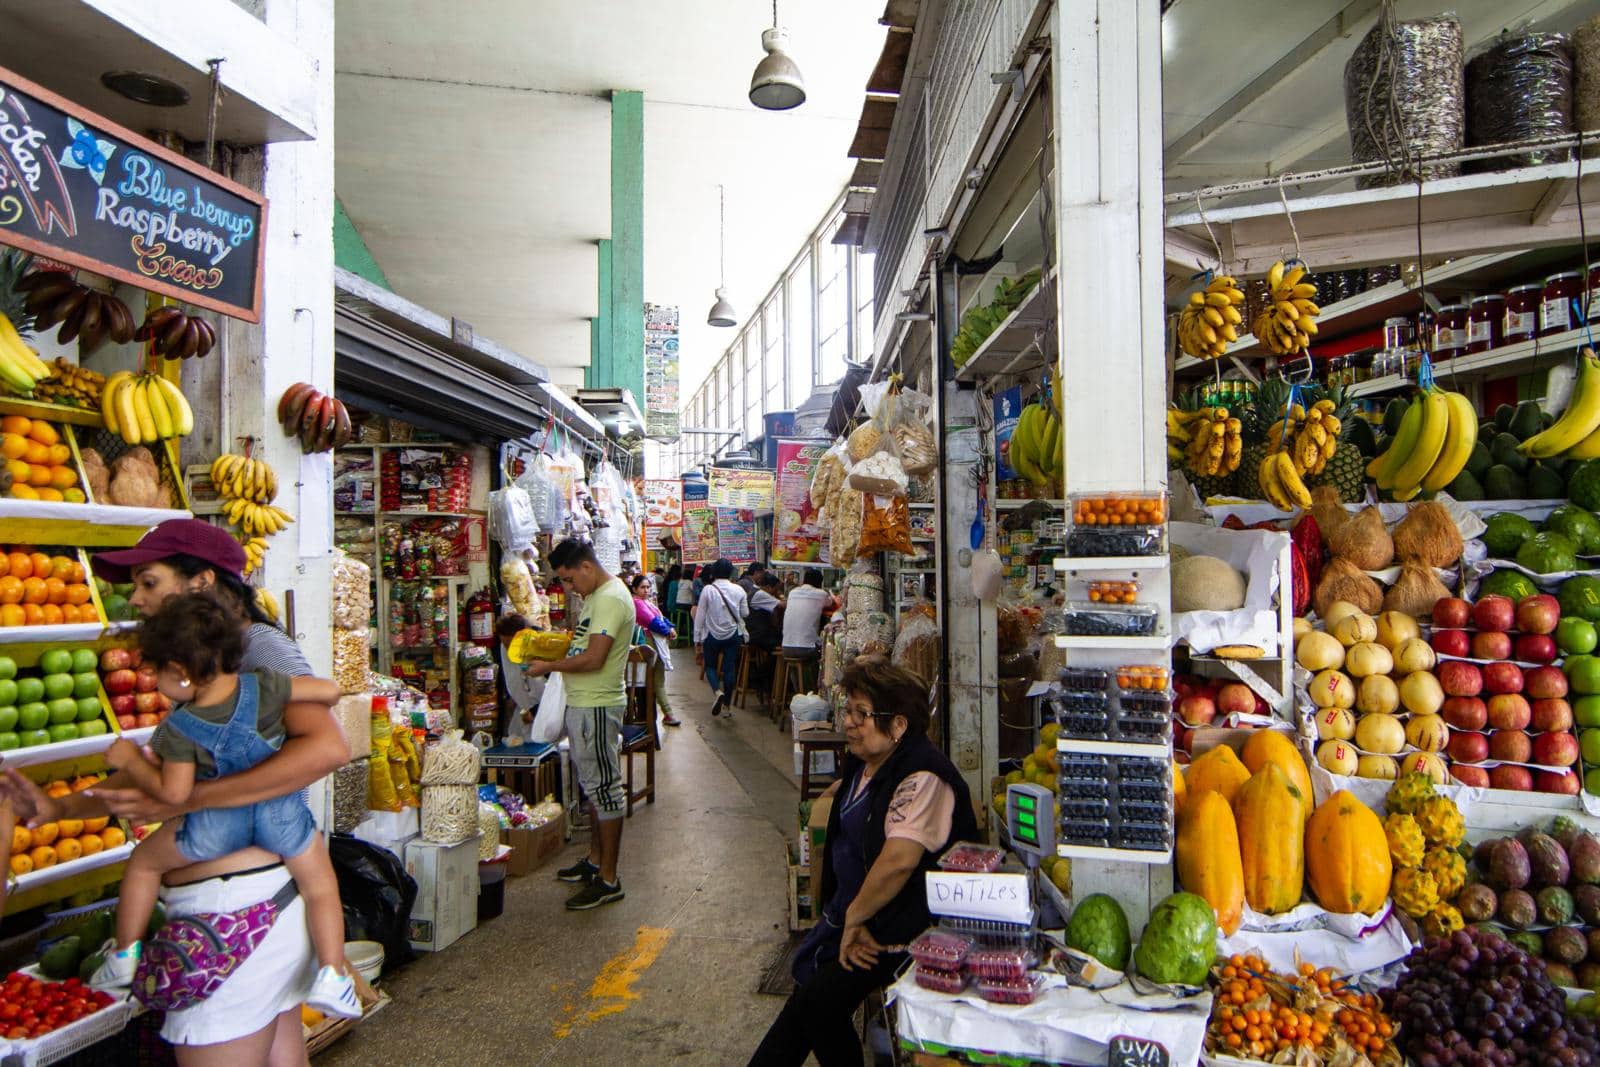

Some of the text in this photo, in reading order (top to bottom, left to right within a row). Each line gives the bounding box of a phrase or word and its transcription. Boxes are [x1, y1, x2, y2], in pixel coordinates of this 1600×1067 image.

[95, 187, 233, 266] Raspberry
[118, 150, 255, 247] Blue berry
[1117, 1038, 1161, 1064] UVA
